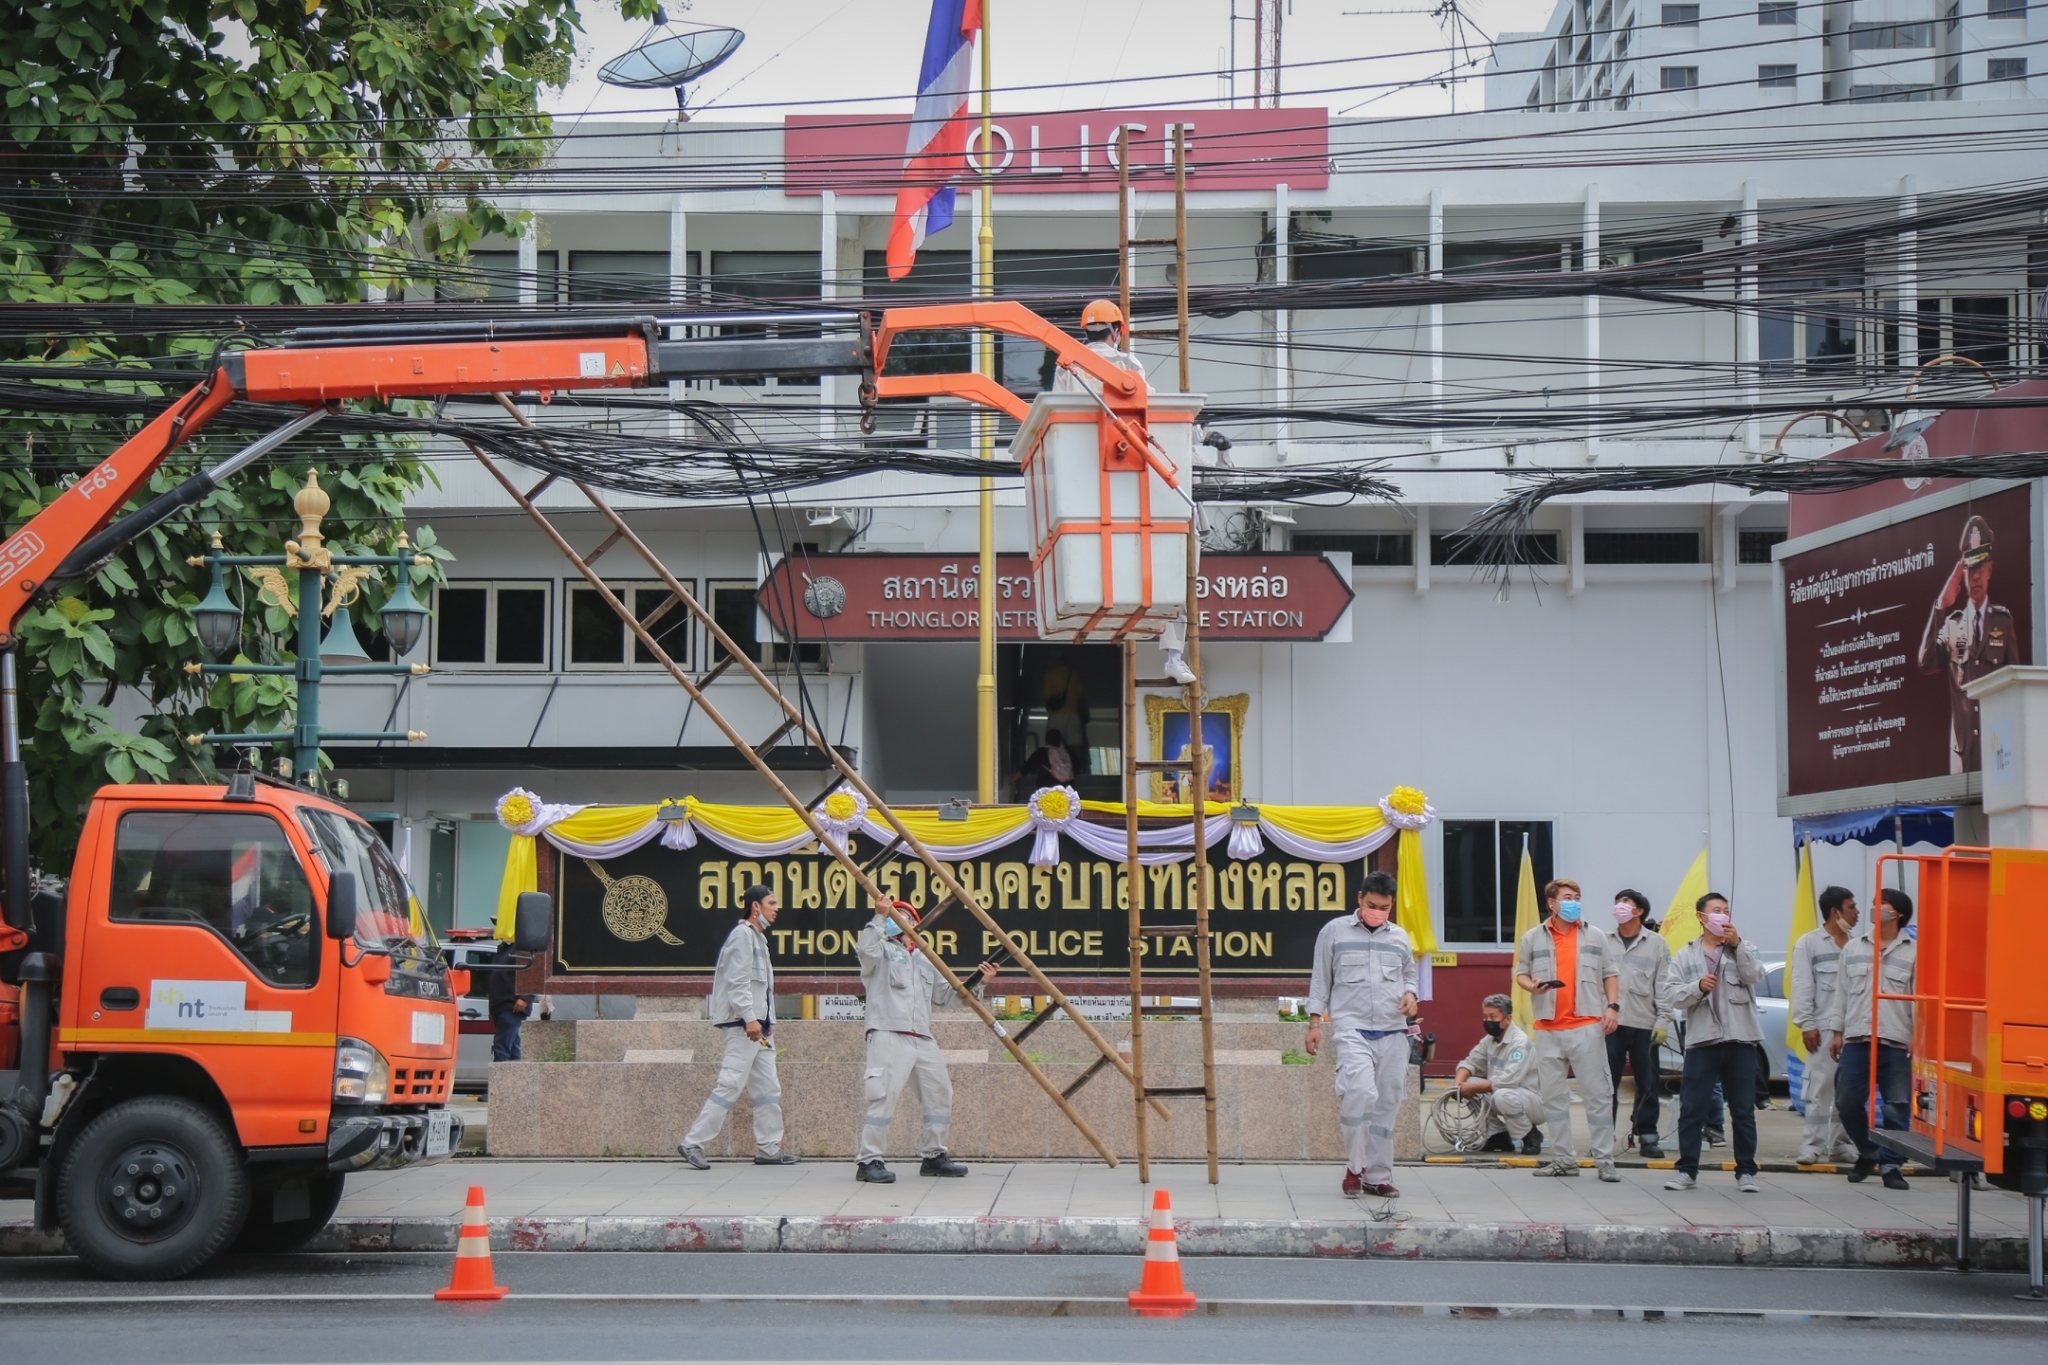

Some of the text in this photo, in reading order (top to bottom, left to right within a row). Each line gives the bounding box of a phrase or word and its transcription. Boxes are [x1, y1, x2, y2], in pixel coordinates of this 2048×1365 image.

[965, 122, 1196, 175] OLICE
[78, 463, 119, 501] F65
[867, 611, 980, 629] THONGLOR
[1217, 610, 1303, 629] STATION
[771, 930, 1273, 957] THONOR POLICE STAION
[178, 998, 206, 1019] nt
